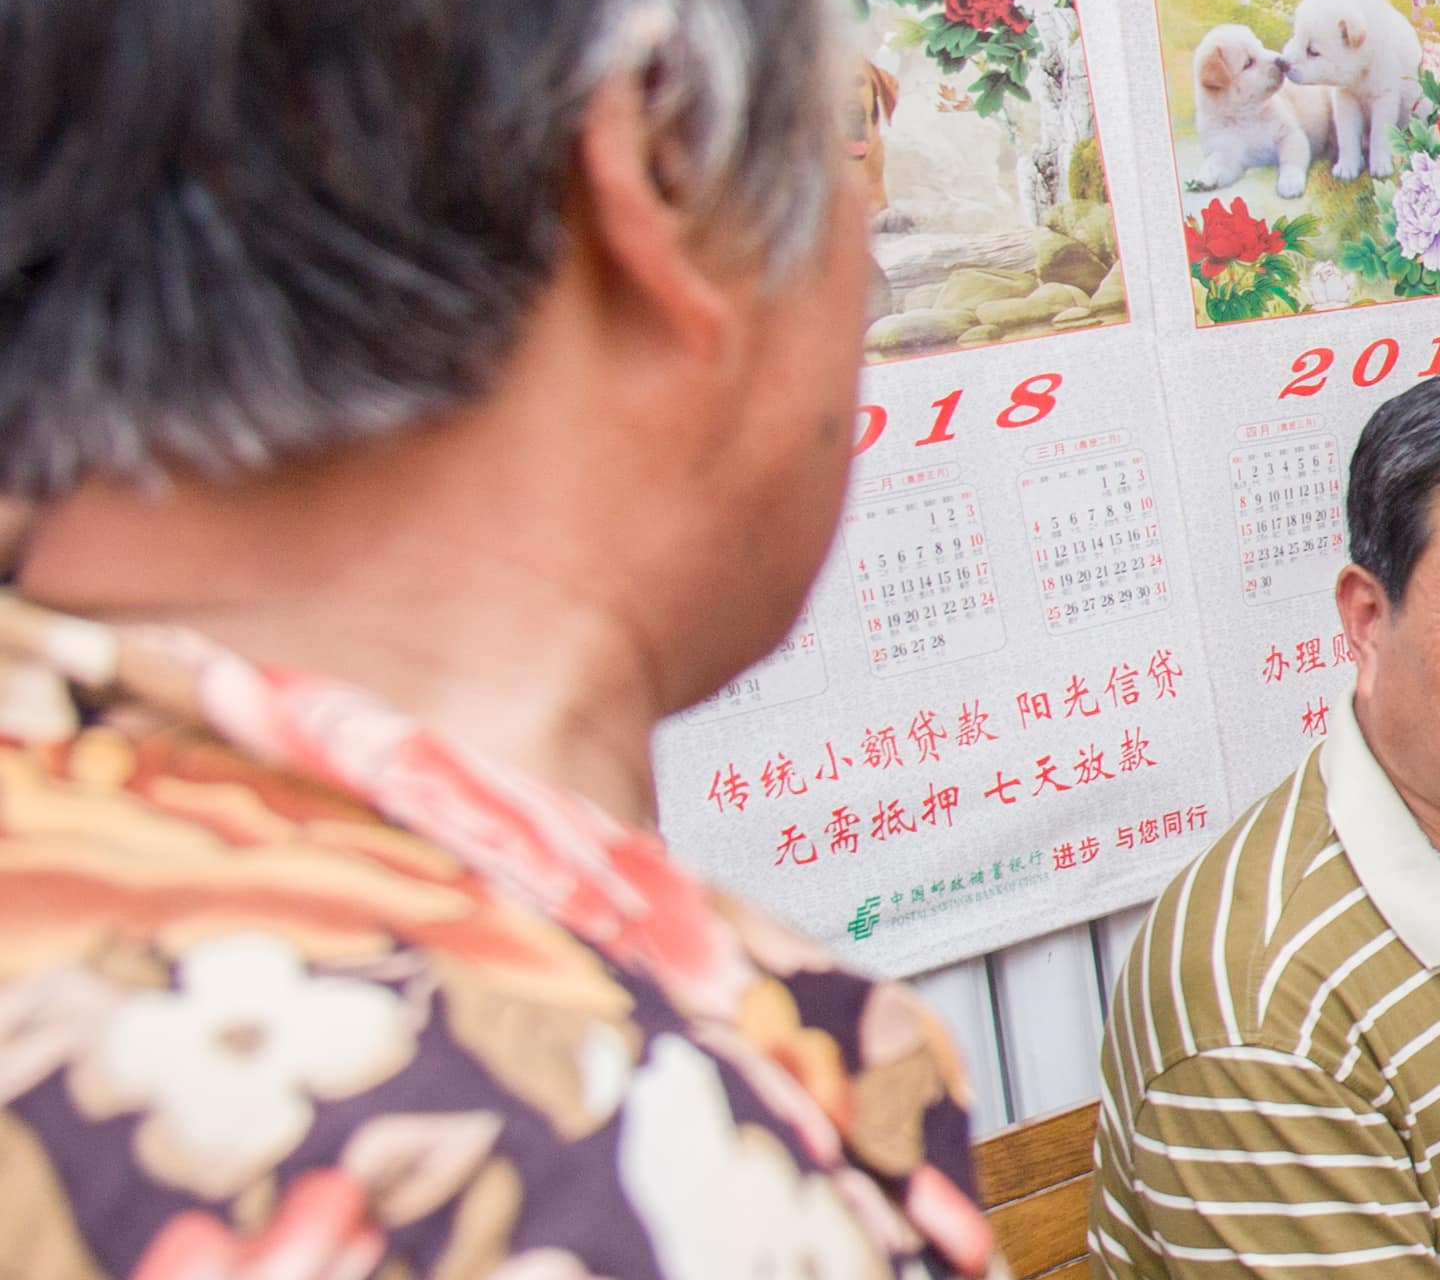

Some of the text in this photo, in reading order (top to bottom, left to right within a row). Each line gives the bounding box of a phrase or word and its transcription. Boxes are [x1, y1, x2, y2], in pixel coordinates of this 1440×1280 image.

[1037, 443, 1065, 460] 三月
[863, 476, 893, 494] 二月
[1102, 469, 1145, 489] 1 2 3
[930, 505, 975, 525] 1 2 3
[1033, 496, 1153, 534] 4 5 6 7 8 9 10
[859, 533, 983, 571] 4 5 6 7 8 9 10
[1035, 525, 1158, 562] 11 12 13 14 15 16 17
[861, 562, 989, 603] 11 12 13 14 15 16 17
[1042, 553, 1163, 591] 18 19 20 21 22 23 24
[868, 592, 994, 633] 18 19 20 21 22 23 24
[1047, 580, 1167, 621] 25 26 27 28 29 30 31
[801, 632, 815, 648] 27
[873, 635, 945, 663] 25 26 27 28
[744, 679, 760, 695] 31
[705, 647, 1184, 815] 传统小额贷款 阳光信贷
[1302, 696, 1329, 738] 材
[773, 726, 1159, 869] 无需抵押 七天放款
[889, 803, 1209, 907] 中国邮政储蓄银行 进步 与您同行
